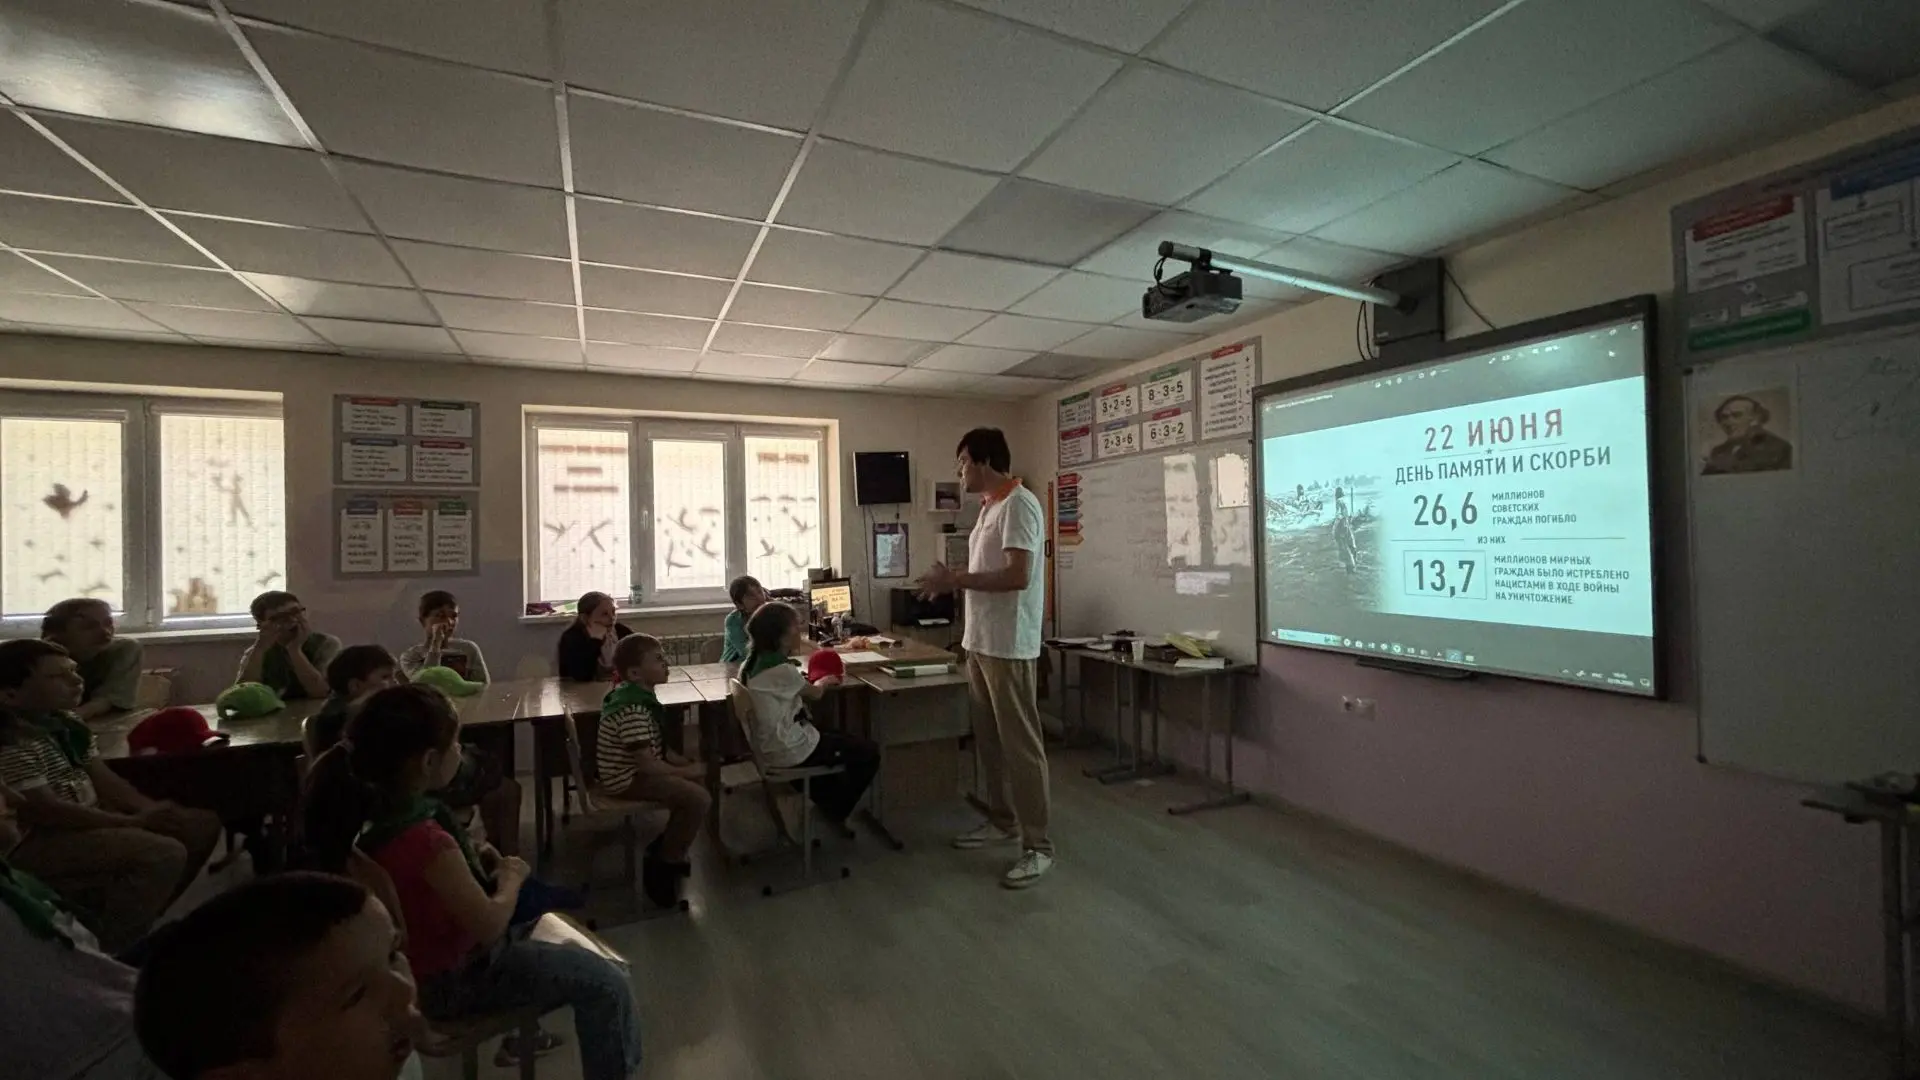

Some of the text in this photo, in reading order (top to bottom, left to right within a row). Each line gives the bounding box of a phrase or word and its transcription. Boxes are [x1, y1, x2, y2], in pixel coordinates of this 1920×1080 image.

[1424, 408, 1563, 452] 22 ИЮНЯ
[1395, 446, 1612, 486] ДЕНЬ ПАМЯТИ И СКОРБИ
[1492, 490, 1545, 501] МИЛЛИОНОВ
[1413, 491, 1478, 532] 26,6
[1492, 502, 1540, 513] СОВЕТСКИХ
[1492, 514, 1577, 526] ГРАЖДАН ПОГИБЛО
[1477, 536, 1506, 545] ИЗ НИХ
[1494, 555, 1592, 565] МИЛЛИОНОВ МИРНЫХ
[1413, 559, 1476, 598] 13,7
[1494, 568, 1630, 580] ГРАЖДАН БЫЛО ИСТРЕБЛЕНО
[1494, 580, 1620, 593] НАЦИСТАМИ В ХОДЕ ВОЙНЫ
[1495, 592, 1574, 604] НА УНИЧТОЖЕНИЕ
